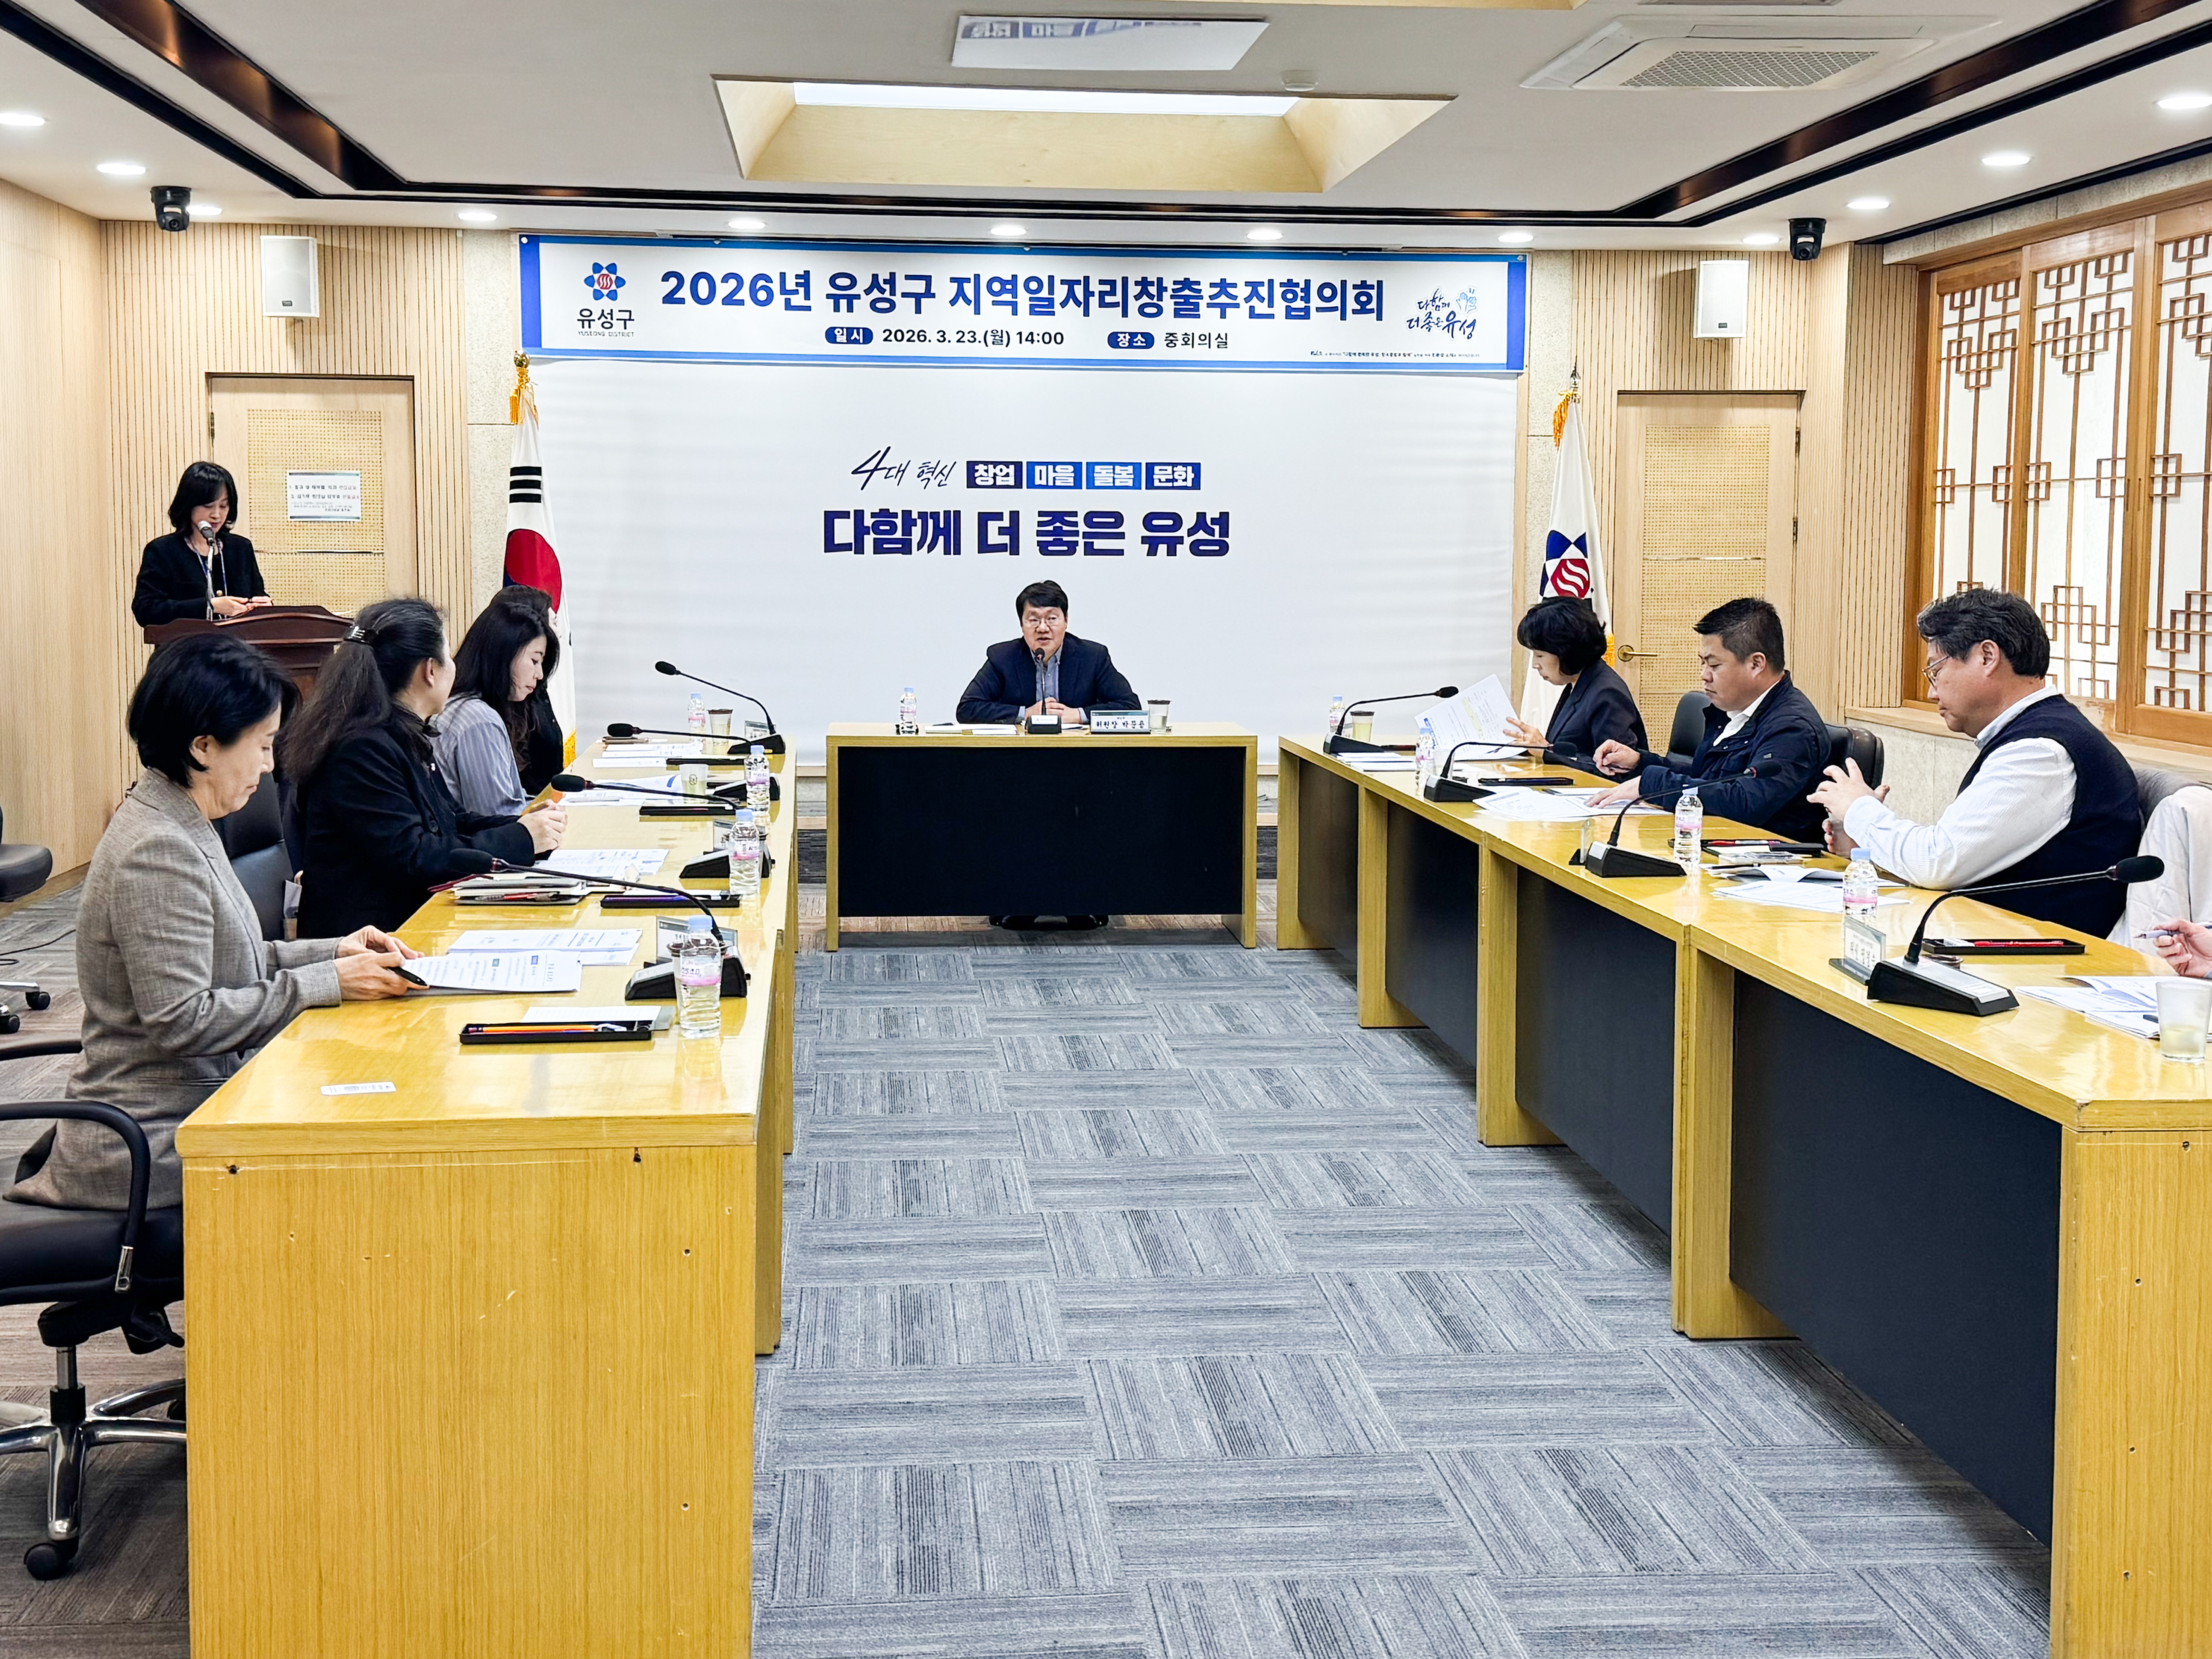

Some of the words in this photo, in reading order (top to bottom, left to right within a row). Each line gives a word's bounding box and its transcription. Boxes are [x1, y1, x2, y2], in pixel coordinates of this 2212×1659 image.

[661, 270, 811, 311] 2026년
[826, 272, 935, 314] 유성구
[949, 274, 1383, 321] 지역일자리창출추진협의회
[1417, 289, 1449, 311] 다함께
[577, 309, 634, 330] 유성구
[1407, 316, 1419, 329] 더
[1420, 311, 1443, 332] 좋은
[1442, 311, 1476, 339] 유성
[833, 328, 864, 343] 일시
[883, 329, 931, 342] 2026.
[937, 330, 951, 343] 3.
[956, 330, 1010, 347] 23.(월)
[1017, 331, 1063, 344] 14:00
[1117, 333, 1146, 347] 장소
[1164, 333, 1228, 349] 중회의실
[851, 446, 911, 490] 4대
[917, 460, 957, 489] 혁신
[974, 464, 1015, 486] 창업
[1034, 464, 1075, 486] 마을
[1093, 465, 1134, 486] 돌봄
[1152, 465, 1195, 486] 문화
[823, 508, 961, 555] 다함께
[977, 510, 1019, 555] 더
[1036, 511, 1125, 556] 좋은
[1140, 512, 1229, 556] 유성
